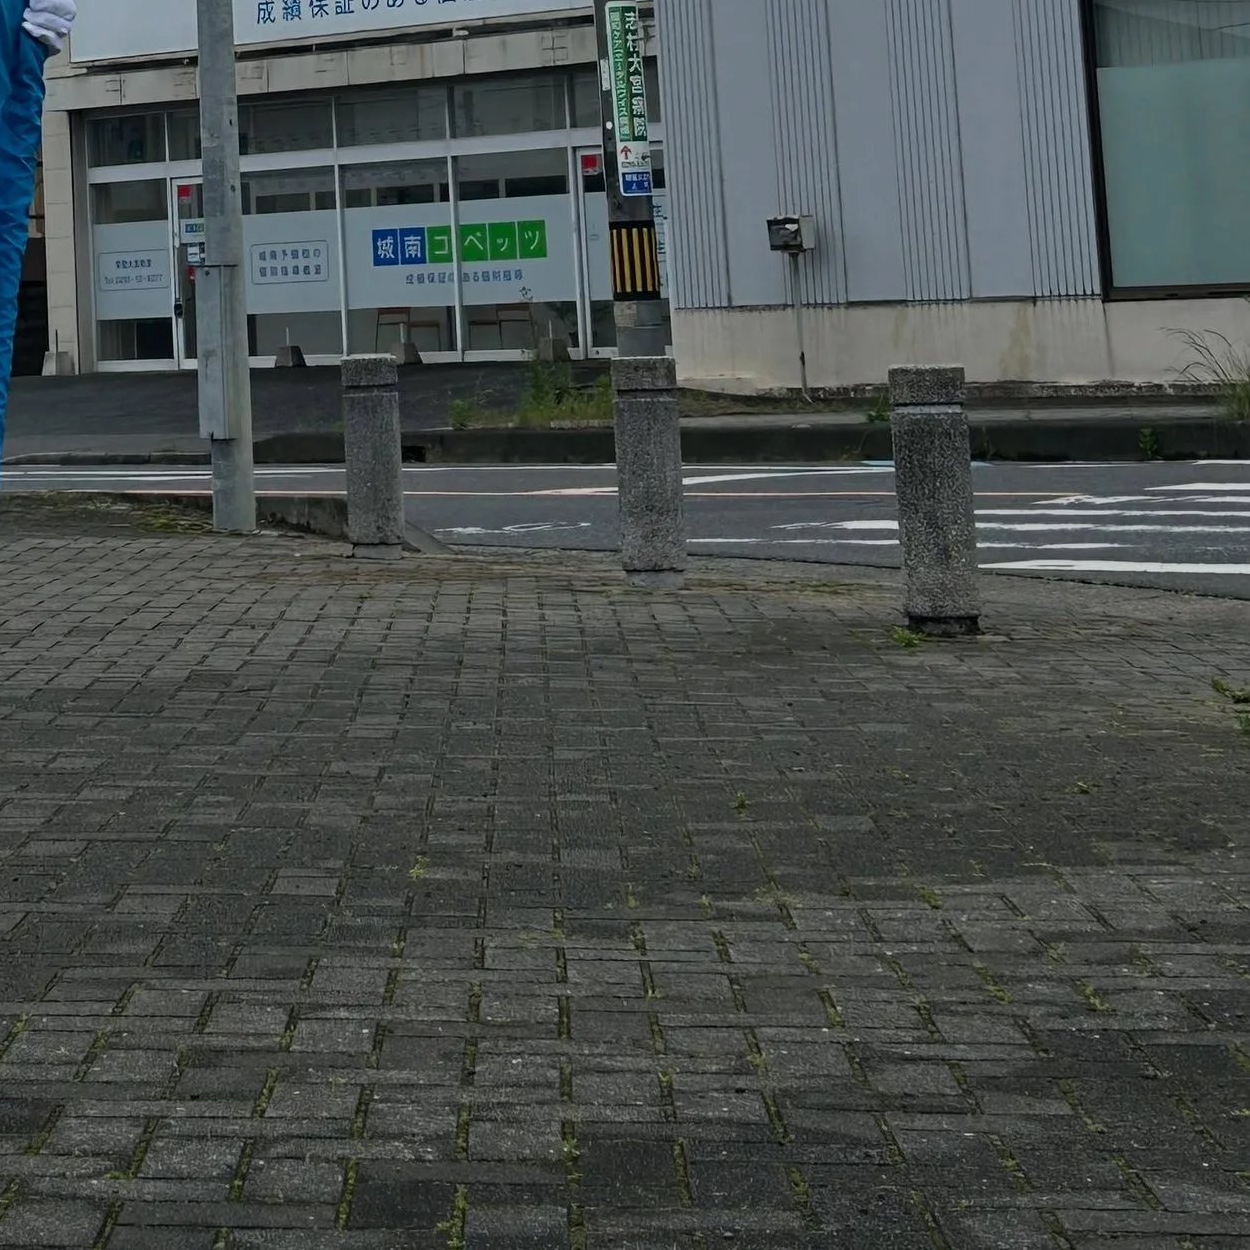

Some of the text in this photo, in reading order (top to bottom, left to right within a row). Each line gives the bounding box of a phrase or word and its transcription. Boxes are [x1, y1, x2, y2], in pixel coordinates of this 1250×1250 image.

[376, 230, 540, 259] 城南コベッツ
